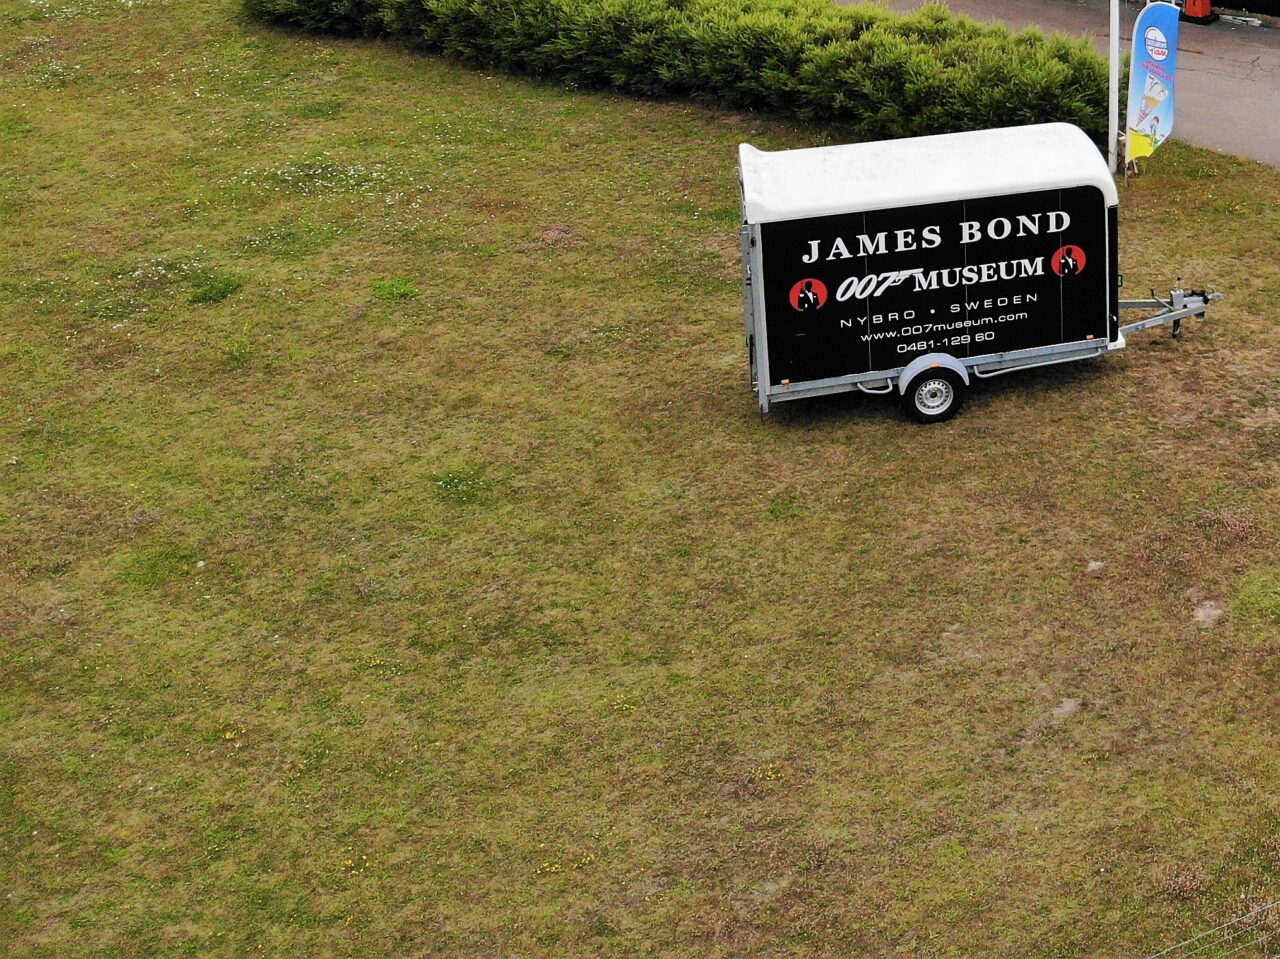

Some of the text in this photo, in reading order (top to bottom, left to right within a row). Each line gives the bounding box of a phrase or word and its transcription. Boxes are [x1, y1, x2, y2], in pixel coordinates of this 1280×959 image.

[802, 210, 1072, 264] JAMES BOND
[836, 256, 1045, 302] 007 MUSEUM
[840, 293, 1039, 329] NYBRO SWEDEN
[860, 312, 1028, 343] www.007museum.com
[896, 330, 996, 354] 0481-129 60
